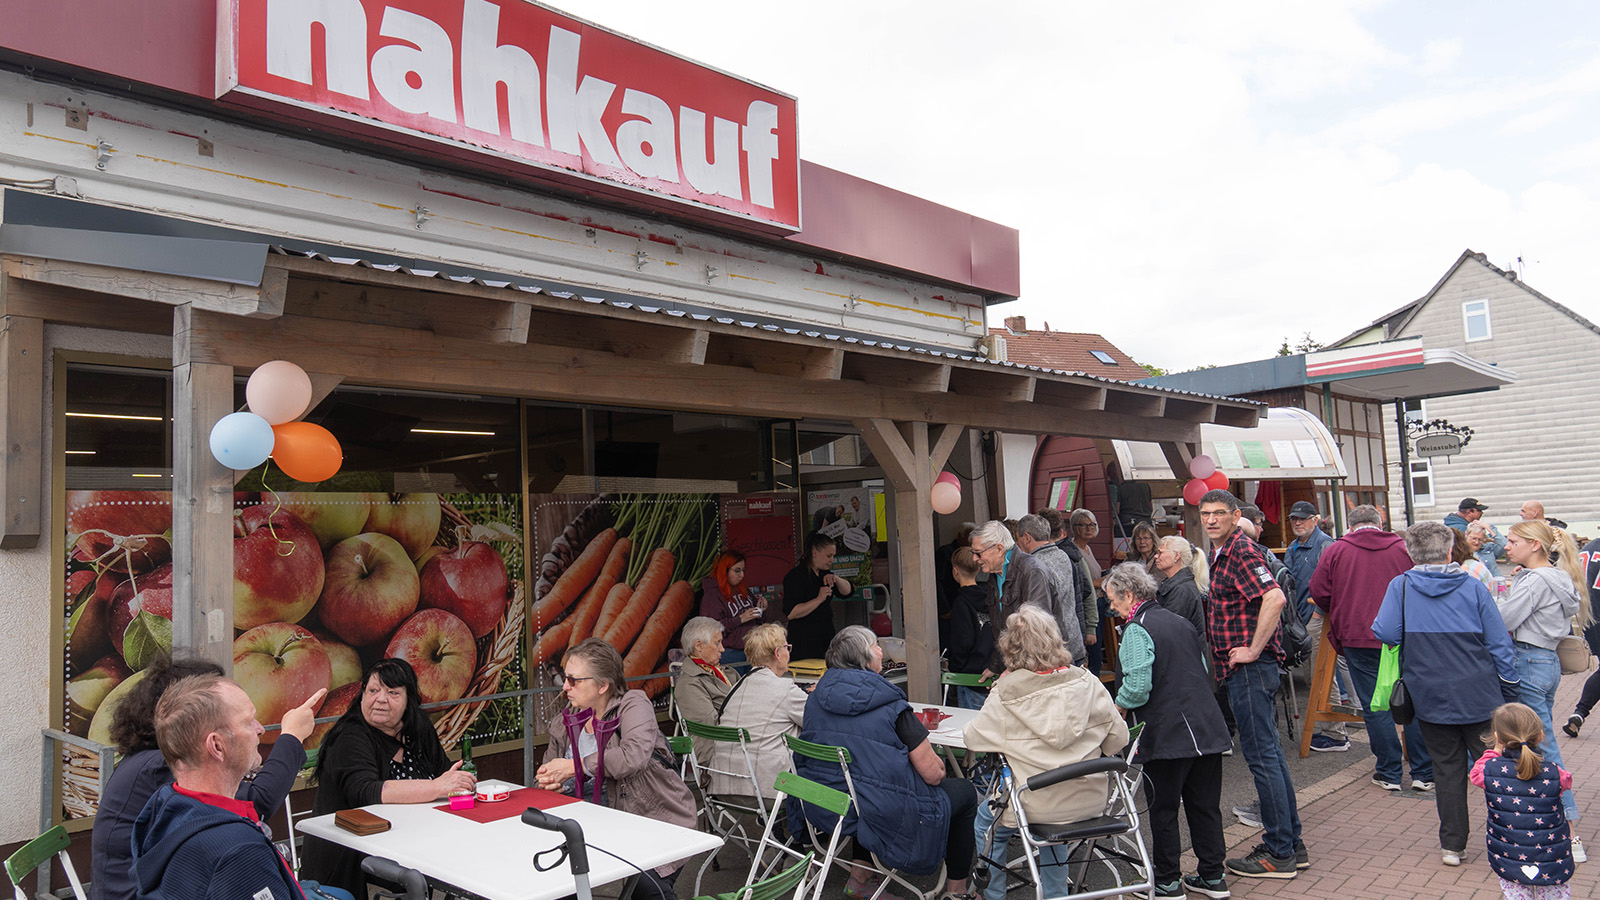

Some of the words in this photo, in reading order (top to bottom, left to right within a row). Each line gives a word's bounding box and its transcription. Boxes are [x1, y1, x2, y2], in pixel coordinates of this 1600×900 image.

[266, 0, 779, 210] nahkauf
[1420, 443, 1458, 452] Weinstube
[748, 500, 772, 509] nahkauf
